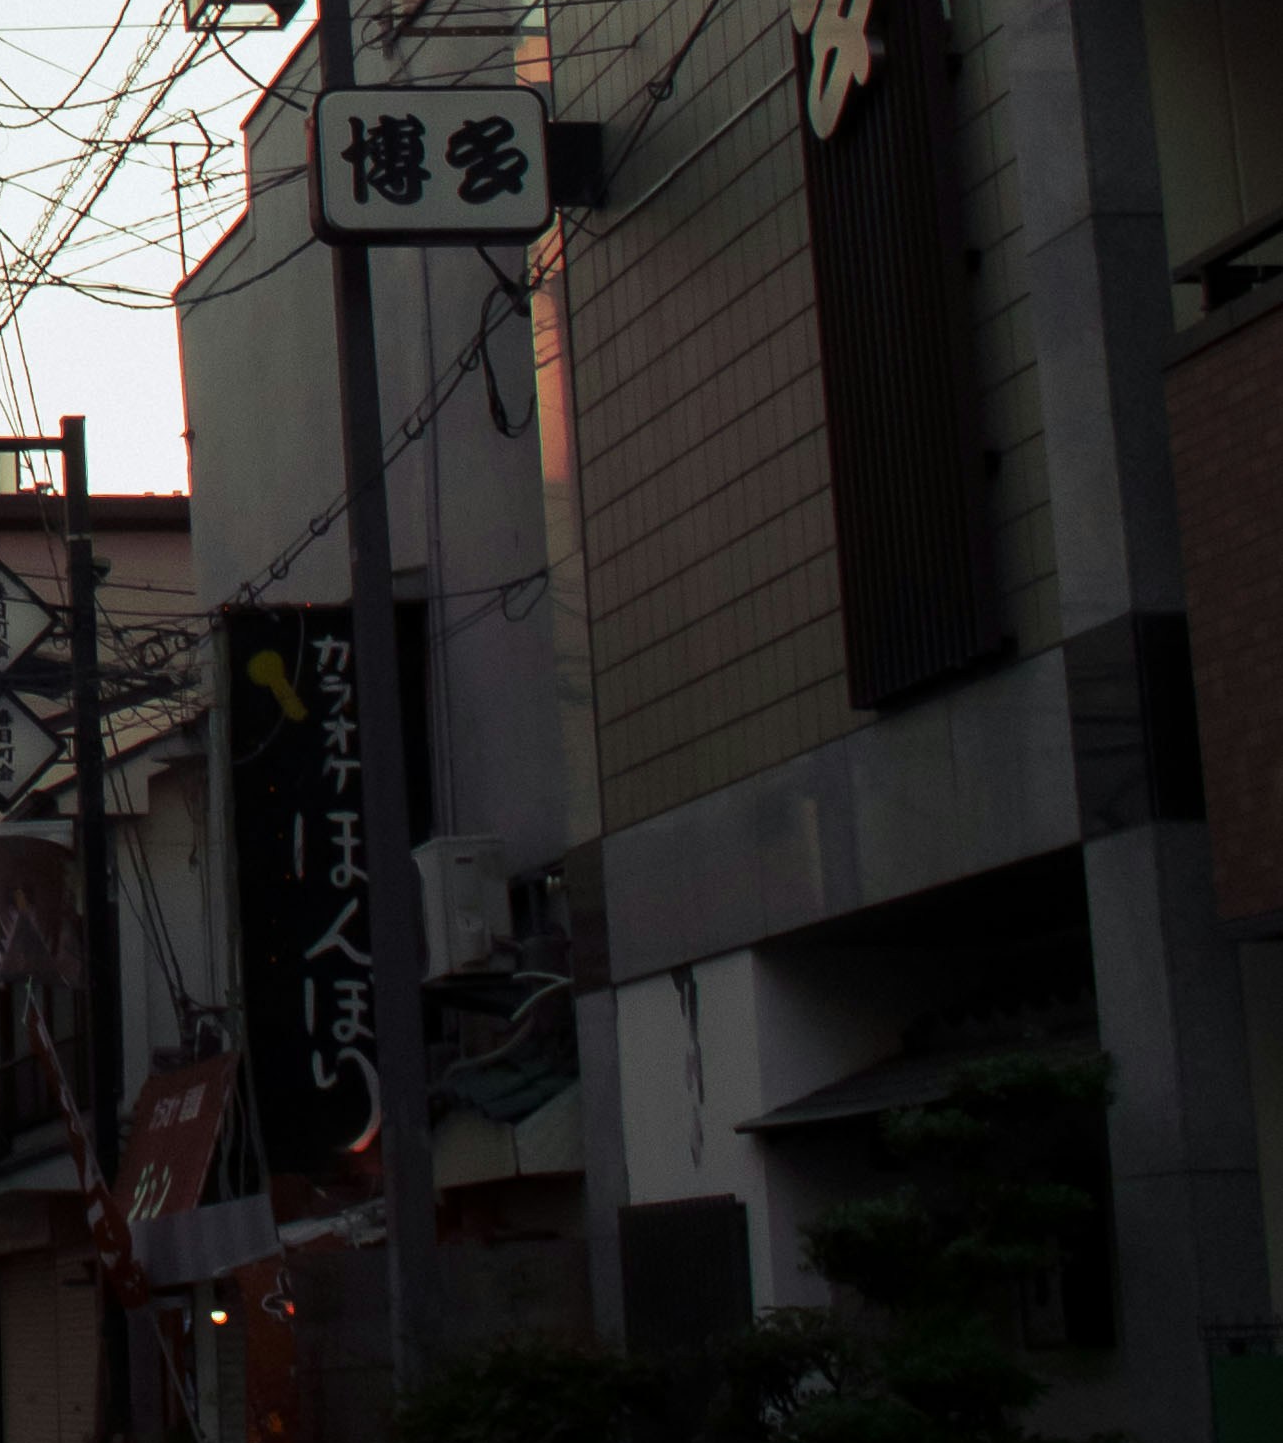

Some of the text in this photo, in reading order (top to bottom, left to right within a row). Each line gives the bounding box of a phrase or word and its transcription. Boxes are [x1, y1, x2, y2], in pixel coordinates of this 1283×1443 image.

[339, 113, 530, 206] 博多
[309, 633, 363, 795] カラオケ
